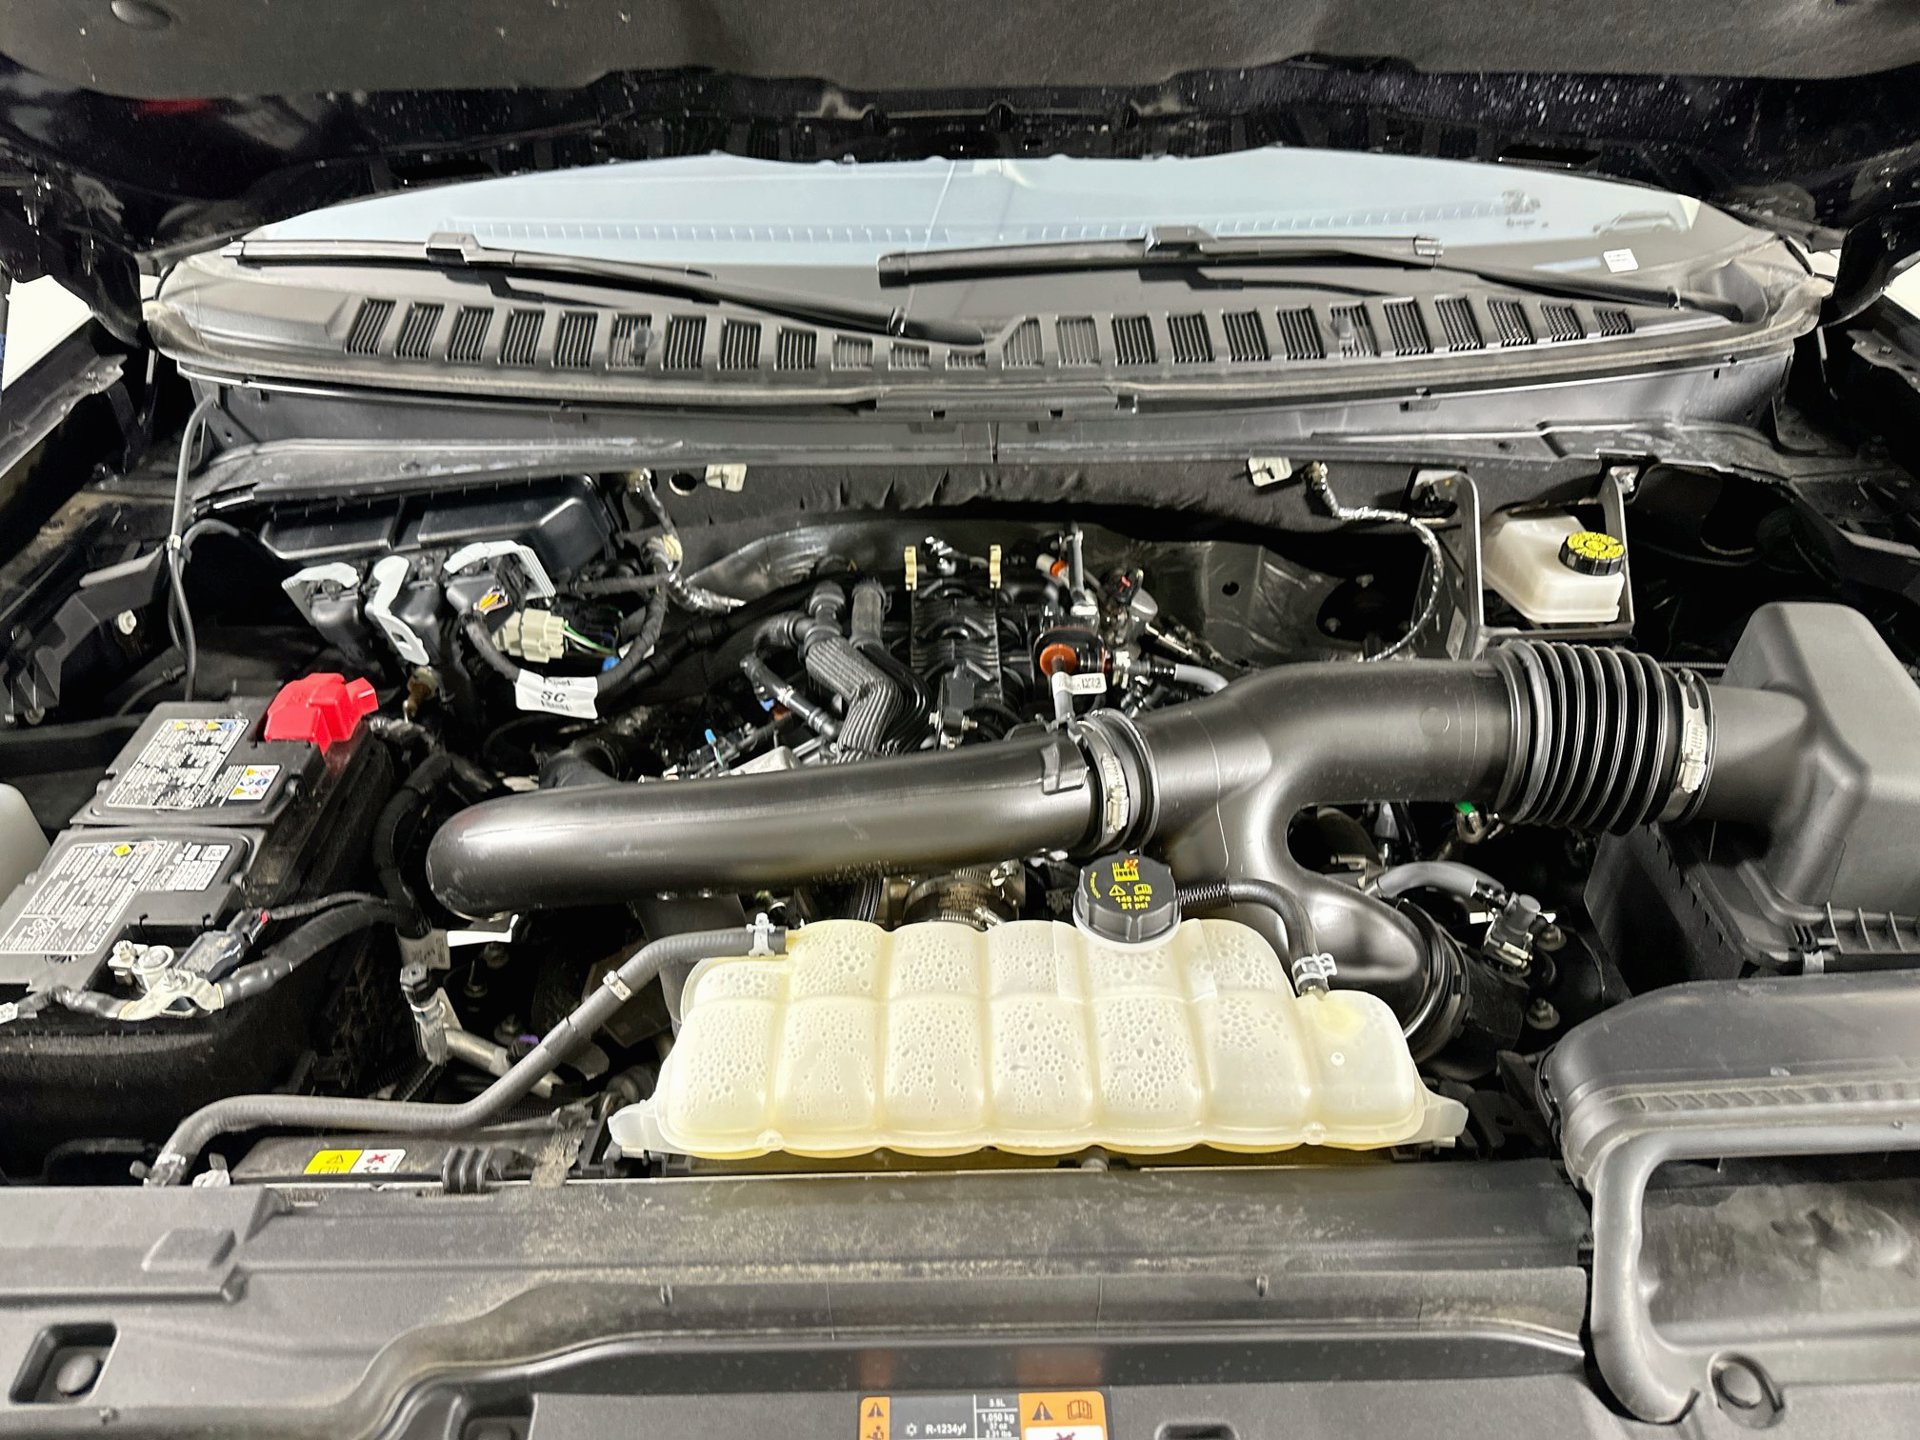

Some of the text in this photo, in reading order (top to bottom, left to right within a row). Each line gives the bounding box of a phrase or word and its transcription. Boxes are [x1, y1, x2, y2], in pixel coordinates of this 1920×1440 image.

[1134, 895, 1152, 903] kPa
[1134, 902, 1149, 911] psi
[1004, 1412, 1015, 1425] kg
[925, 1422, 967, 1436] R-1234yf
